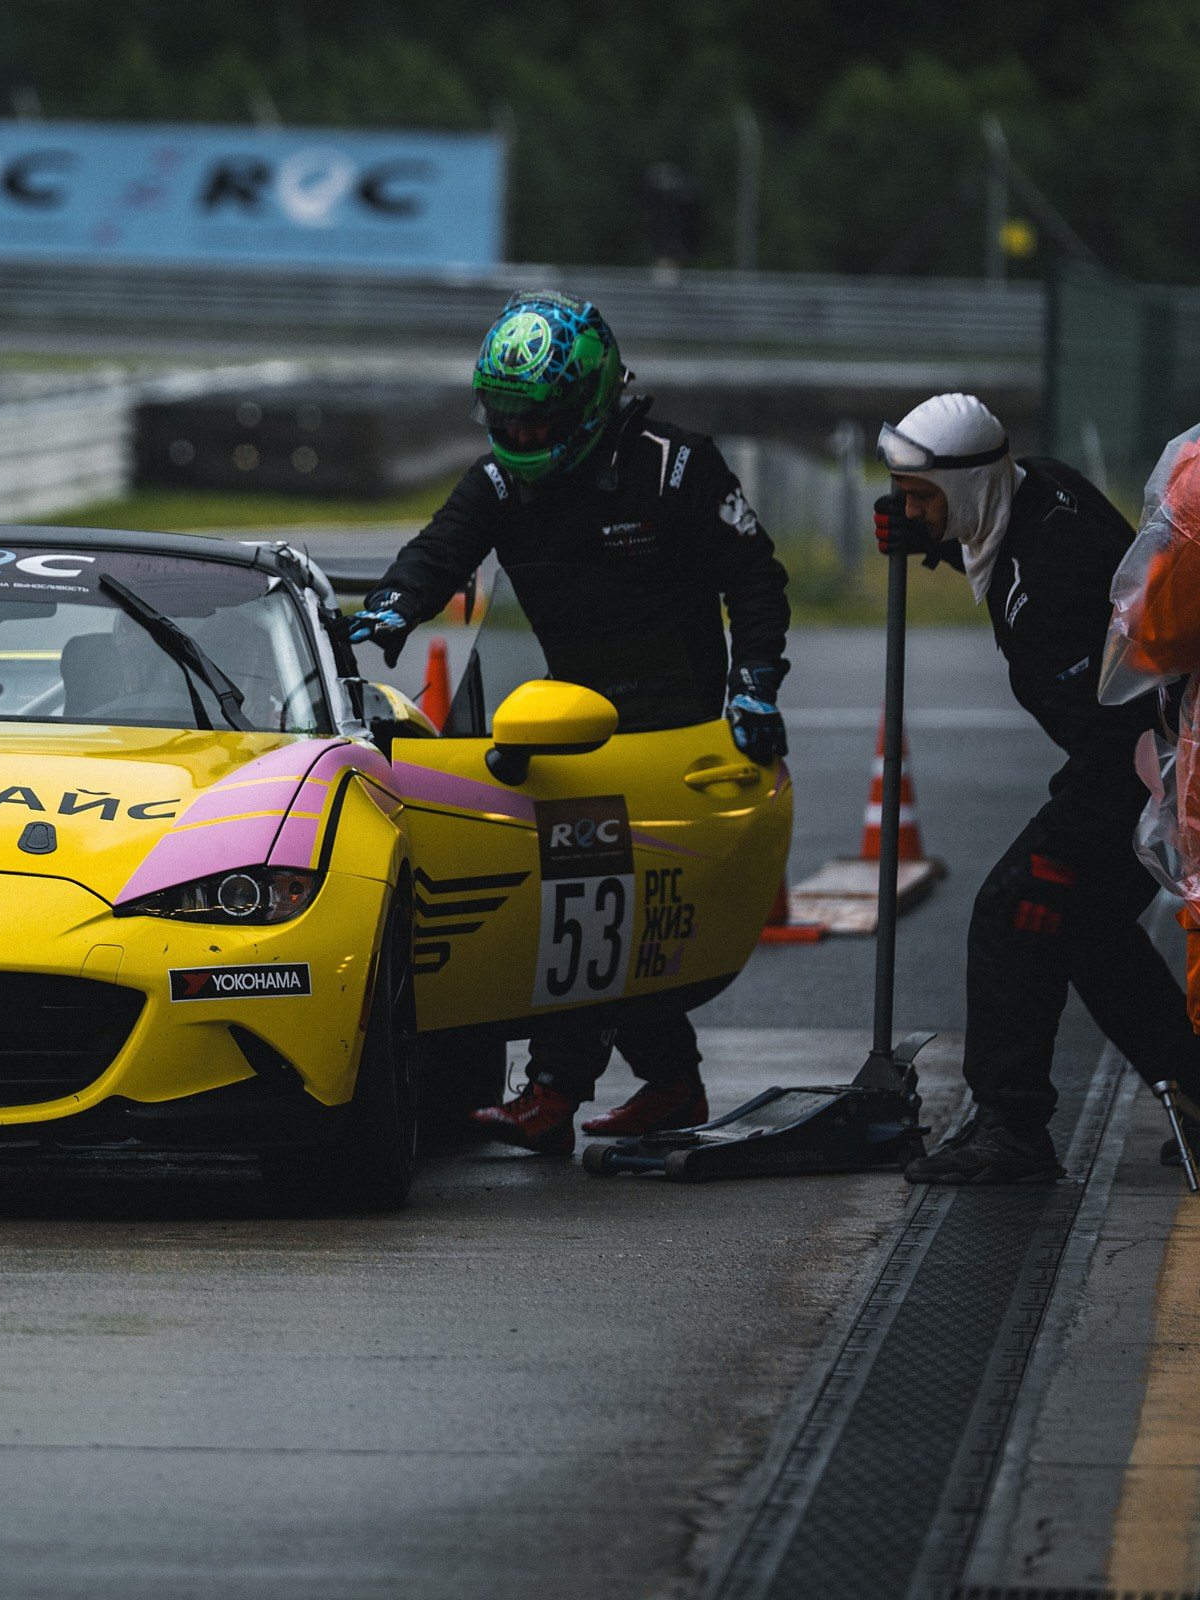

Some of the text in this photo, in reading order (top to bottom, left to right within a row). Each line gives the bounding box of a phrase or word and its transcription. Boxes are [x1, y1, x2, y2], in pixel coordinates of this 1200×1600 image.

[13, 582, 90, 593] ВЫНОСЛИВОСТЬ
[646, 868, 683, 905] РГС
[546, 877, 625, 996] 53
[642, 903, 695, 942] ЖИЗ
[212, 971, 301, 991] YOKOHAMA
